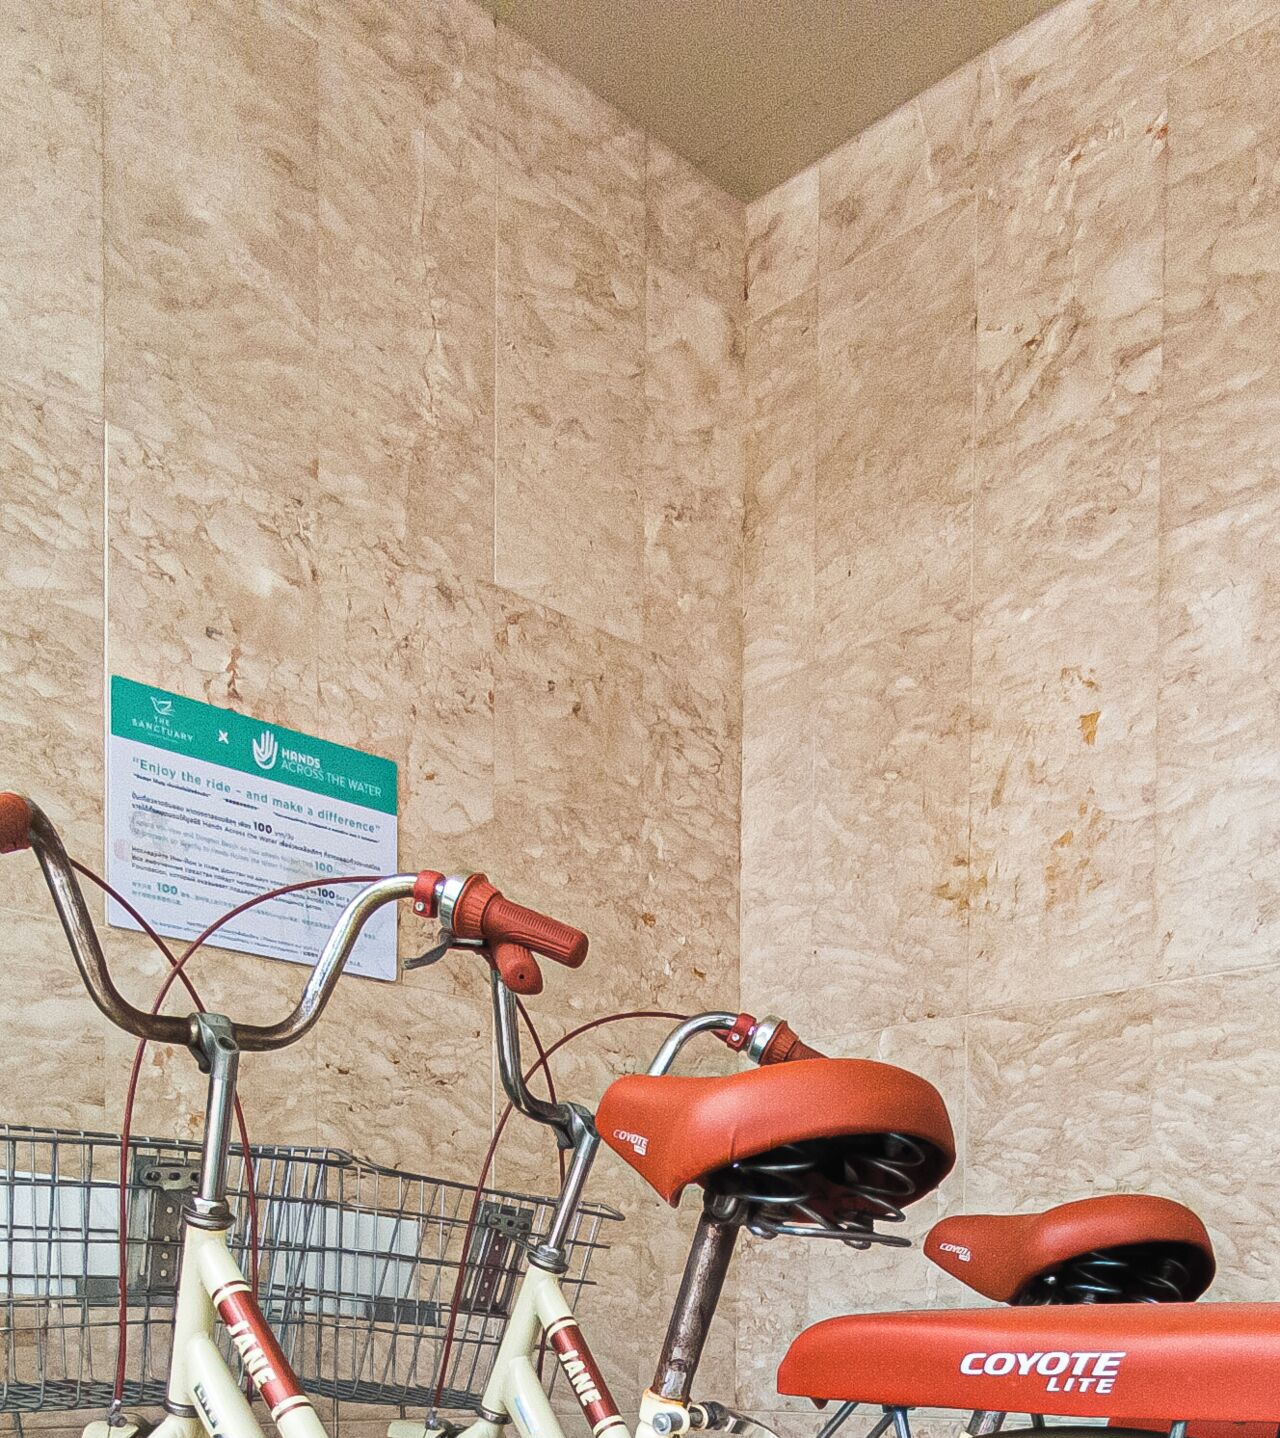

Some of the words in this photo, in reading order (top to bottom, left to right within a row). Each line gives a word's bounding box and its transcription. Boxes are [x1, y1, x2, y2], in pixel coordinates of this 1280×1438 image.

[132, 718, 193, 743] SANCTUARY
[153, 716, 170, 727] THE
[281, 748, 320, 769] HANDS
[281, 760, 324, 781] ACROSS
[327, 772, 345, 788] THE
[348, 779, 381, 798] WATER
[181, 771, 201, 785] the
[206, 779, 231, 793] ride
[246, 790, 267, 804] and
[272, 797, 303, 814] make
[307, 806, 313, 816] a
[253, 821, 273, 835] 100
[315, 861, 333, 874] 100
[157, 882, 178, 896] 100
[317, 887, 336, 900] 100
[613, 1129, 649, 1149] COYOTE
[226, 1320, 277, 1390] JANE
[960, 1352, 1127, 1376] COYOTE
[559, 1350, 602, 1407] JANE
[1046, 1377, 1115, 1394] LITE
